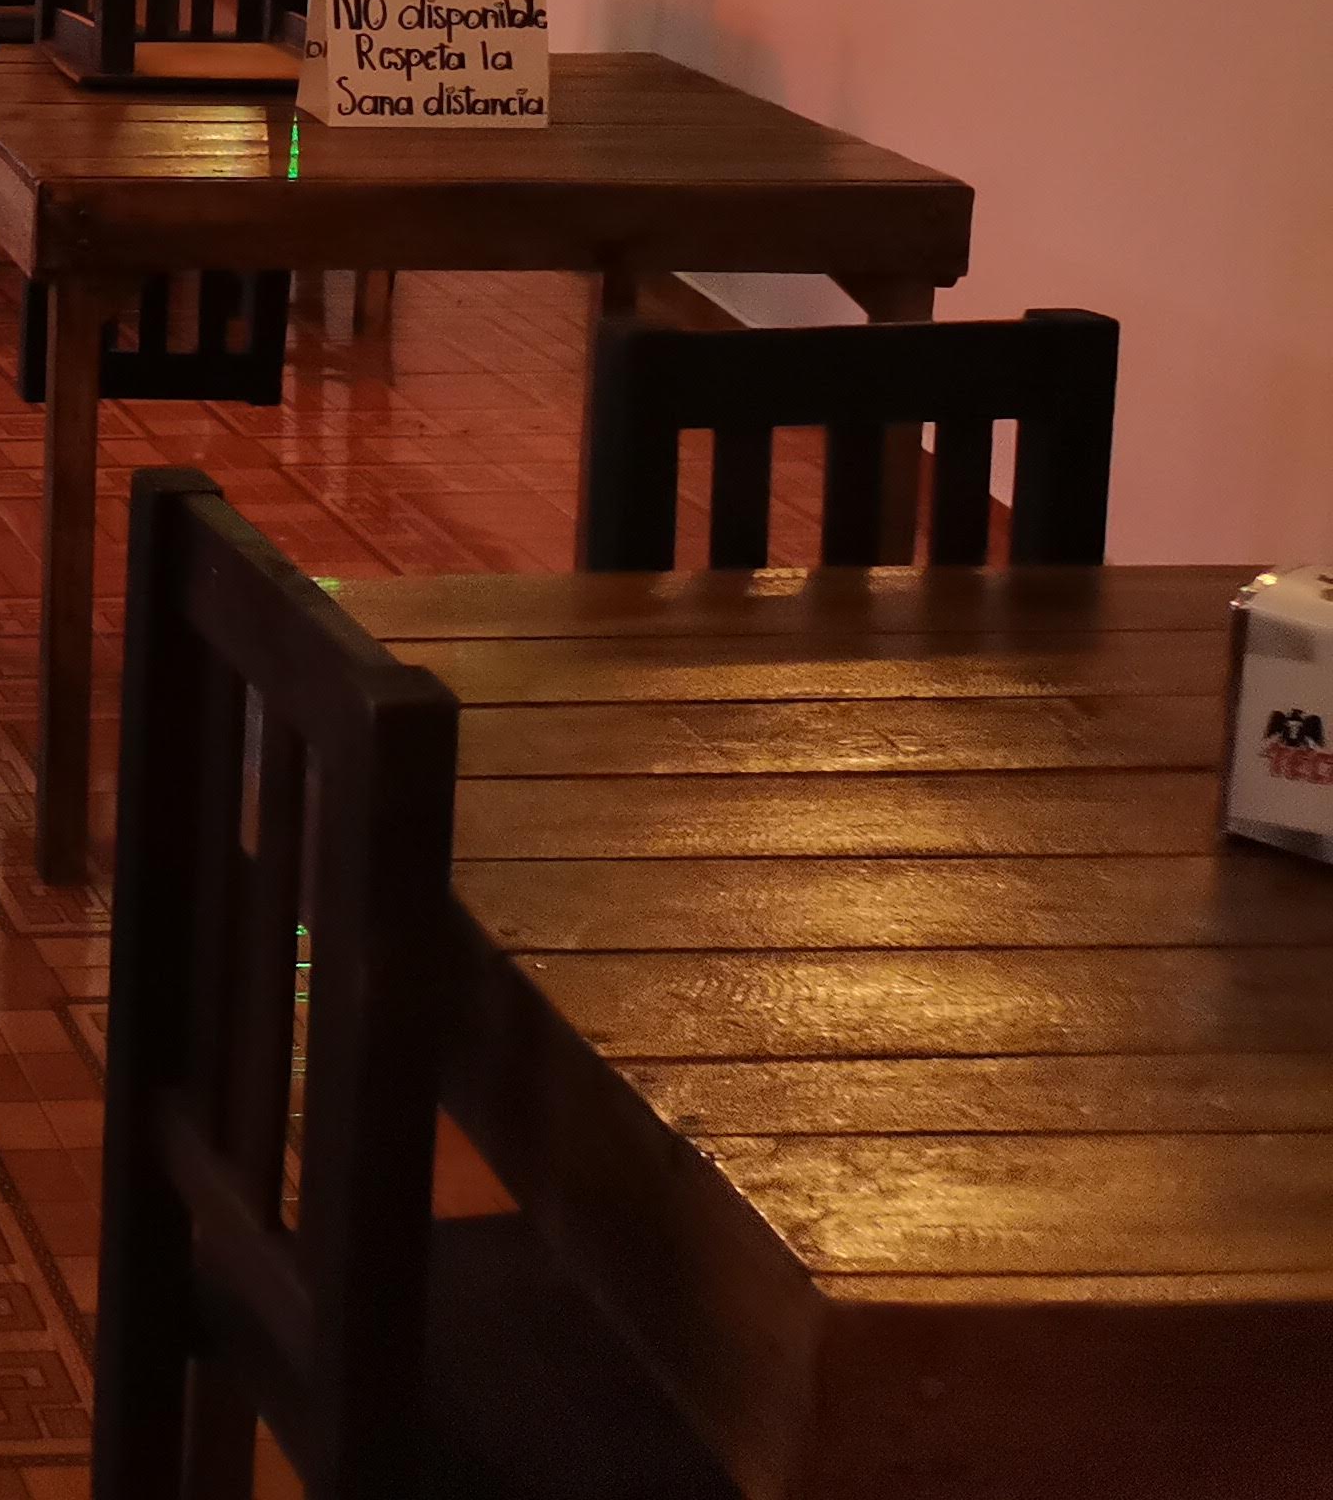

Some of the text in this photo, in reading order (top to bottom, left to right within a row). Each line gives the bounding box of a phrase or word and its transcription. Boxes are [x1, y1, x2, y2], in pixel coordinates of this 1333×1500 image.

[355, 33, 466, 82] Respeta
[480, 41, 514, 71] la
[336, 76, 545, 117] Sana distancia
